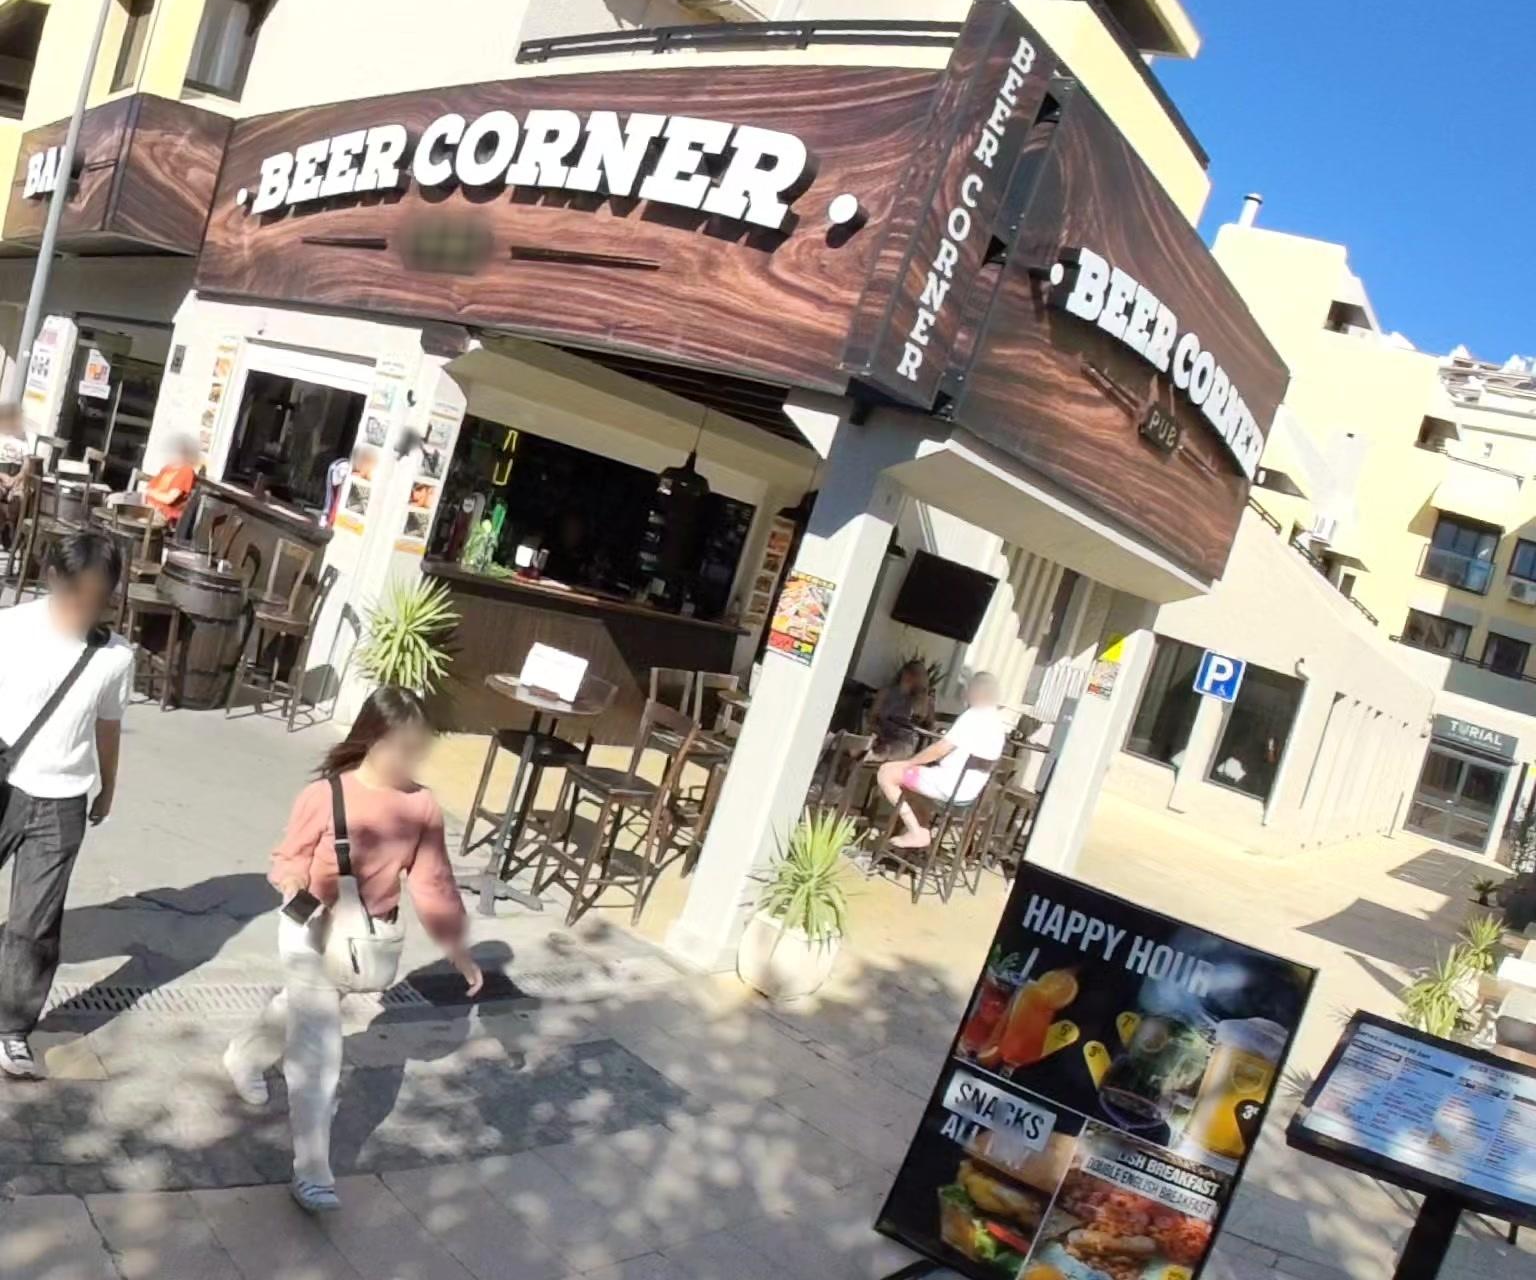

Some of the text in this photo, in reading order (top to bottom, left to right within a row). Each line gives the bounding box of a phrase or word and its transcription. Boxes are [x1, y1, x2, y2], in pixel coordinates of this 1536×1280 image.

[23, 145, 68, 199] BA
[252, 109, 808, 230] BEER CORNER
[896, 38, 1035, 382] BEER CORNER
[1065, 247, 1265, 481] BEER CORNER
[1148, 409, 1177, 447] PUB
[1203, 656, 1233, 691] P
[1450, 721, 1502, 746] TURIAL
[1022, 894, 1216, 998] HAPPY HOUR
[1148, 1158, 1220, 1198] BREAKFAST
[1158, 1184, 1213, 1216] BREAKFAST
